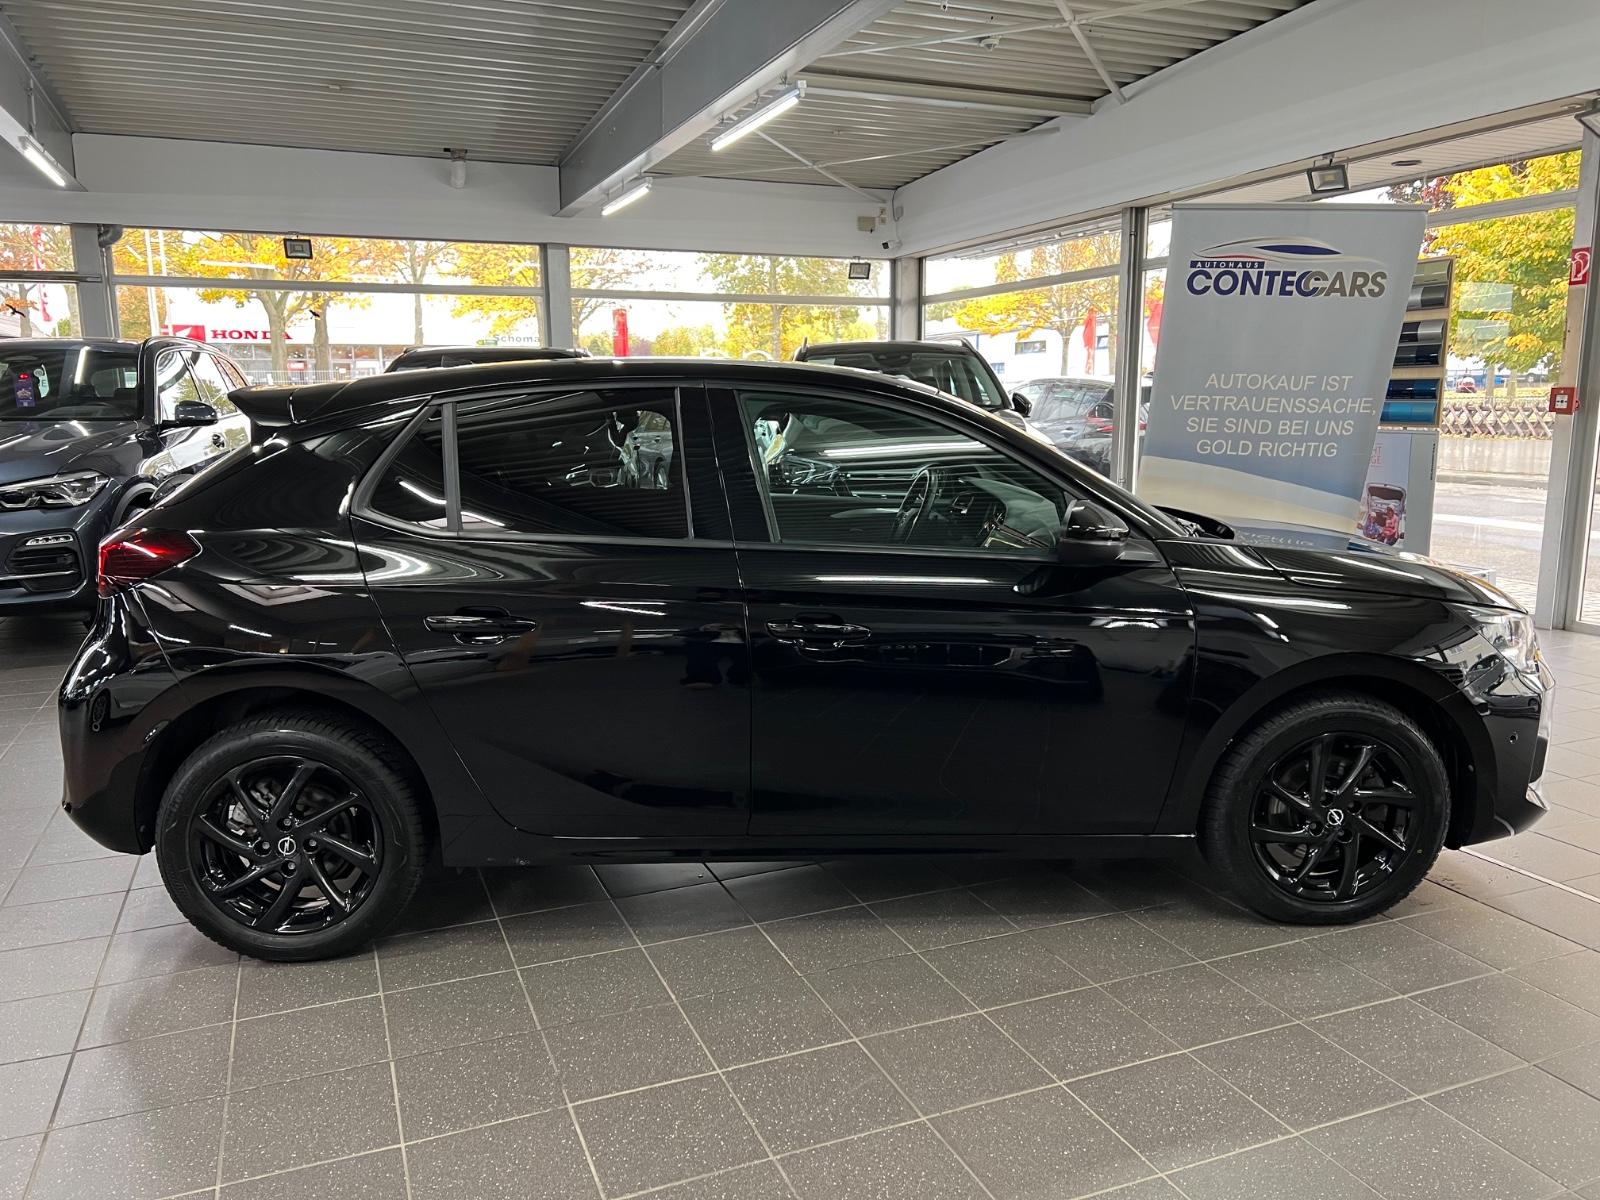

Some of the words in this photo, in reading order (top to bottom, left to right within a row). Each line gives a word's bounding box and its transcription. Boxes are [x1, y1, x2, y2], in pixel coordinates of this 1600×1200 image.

[1195, 261, 1260, 269] AUTOHAUS
[1204, 373, 1317, 391] AUTOKAUF
[1320, 375, 1354, 391] IST
[1170, 395, 1377, 415] VERTRAUENSSACHE,
[1186, 417, 1219, 433] SIE
[1223, 418, 1272, 435] SIND
[1277, 420, 1310, 435] BEI
[1314, 420, 1355, 436] UNS
[1196, 439, 1253, 456] GOLD
[1258, 441, 1339, 457] RICHTIG
